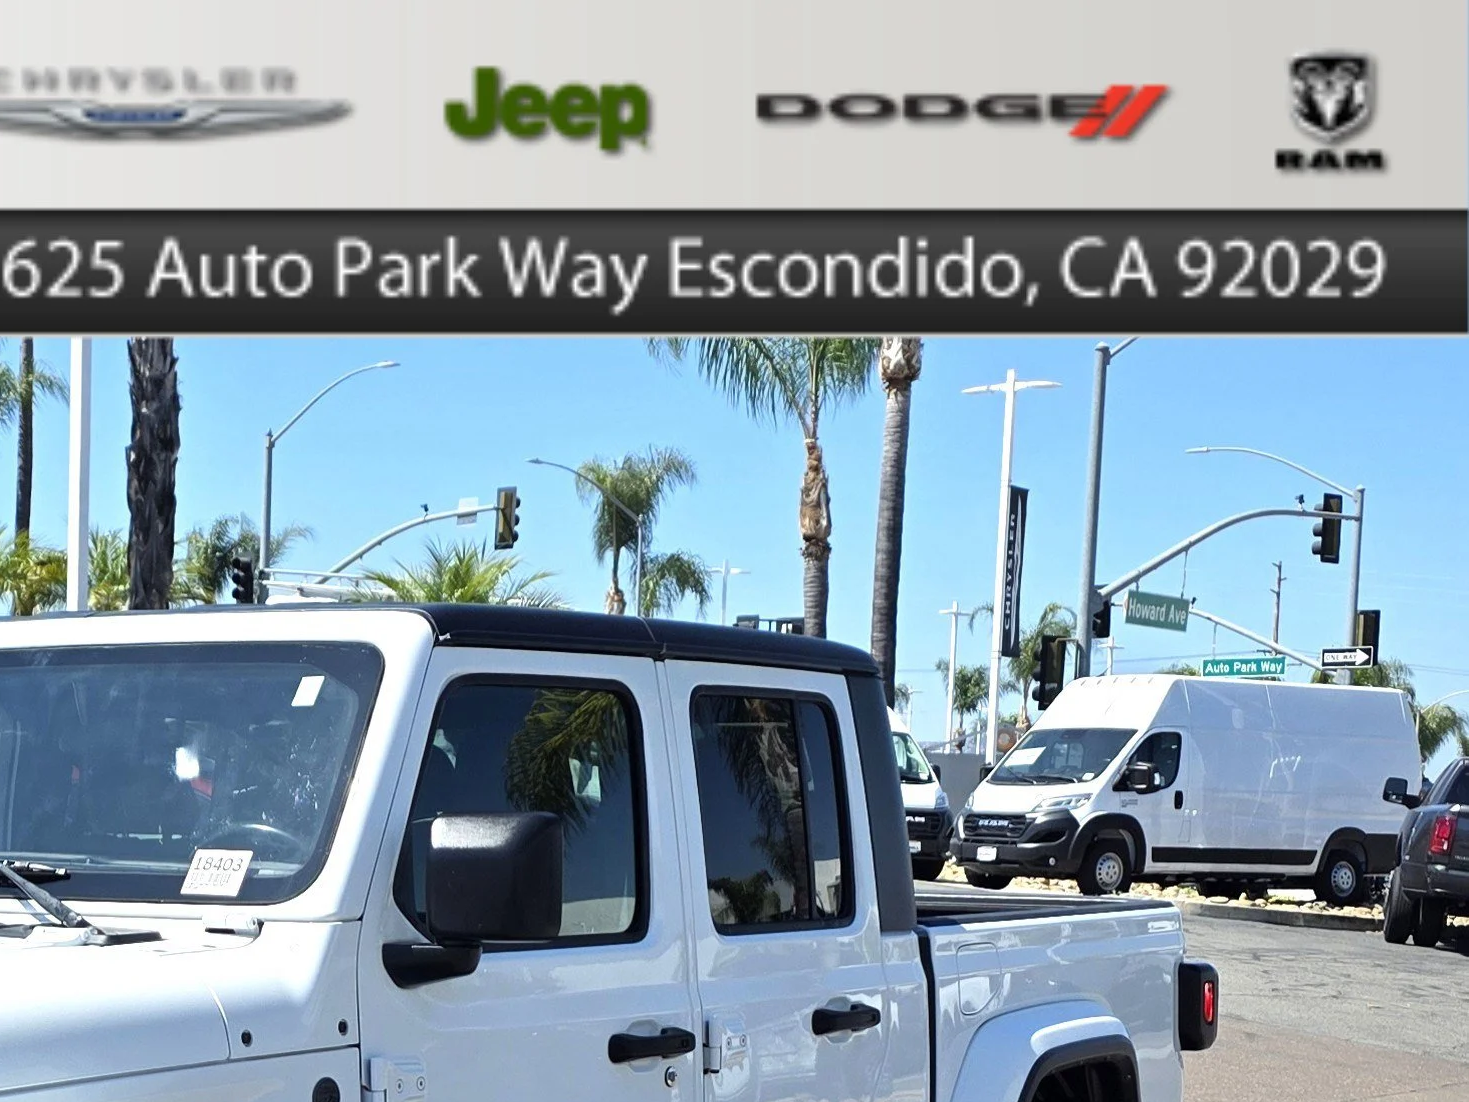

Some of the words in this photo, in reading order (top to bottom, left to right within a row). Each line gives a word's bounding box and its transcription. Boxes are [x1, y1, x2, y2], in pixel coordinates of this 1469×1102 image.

[1005, 513, 1015, 630] CHRYSLER
[1128, 597, 1167, 621] Howard
[1168, 604, 1187, 625] Ave
[1205, 662, 1230, 673] Auto
[1233, 661, 1257, 673] Park
[1261, 660, 1283, 673] Way
[194, 857, 243, 871] 18403
